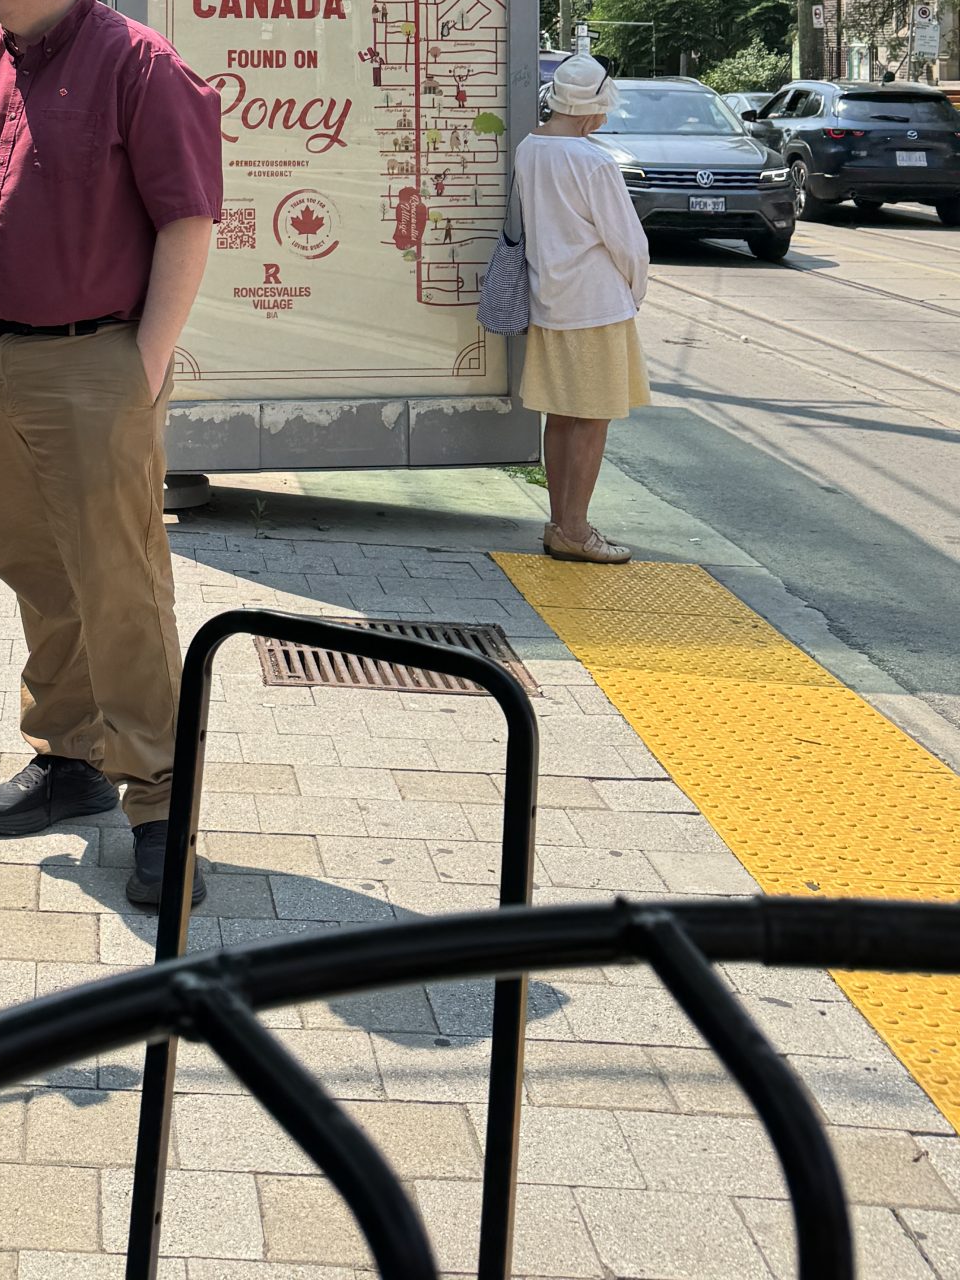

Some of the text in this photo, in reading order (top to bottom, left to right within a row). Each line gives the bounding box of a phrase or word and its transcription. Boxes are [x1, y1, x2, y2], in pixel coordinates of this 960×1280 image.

[227, 49, 318, 69] FOUND ON
[203, 72, 353, 154] Roncy
[233, 286, 311, 298] RONCESVALLES
[252, 299, 293, 310] VILLAGE
[266, 311, 279, 319] BIA
